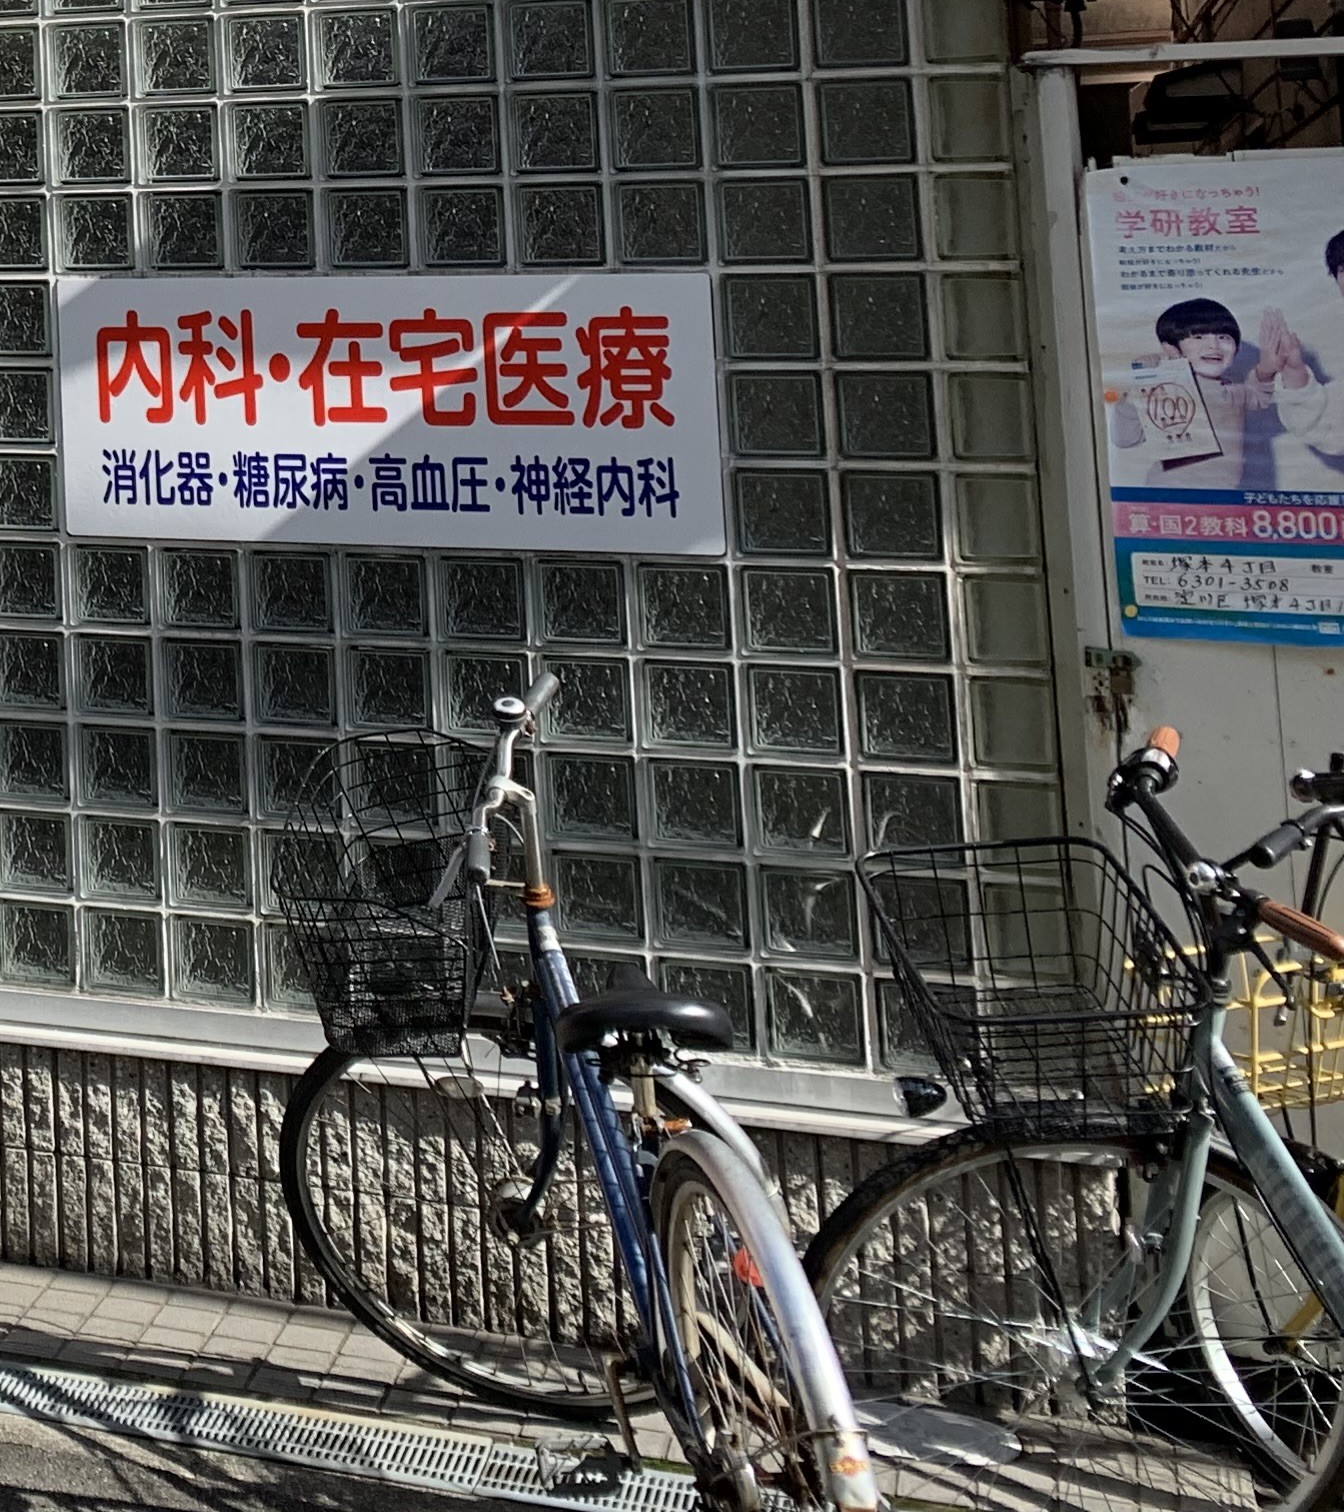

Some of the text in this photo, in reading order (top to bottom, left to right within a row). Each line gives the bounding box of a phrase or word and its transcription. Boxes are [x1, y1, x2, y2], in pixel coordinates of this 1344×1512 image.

[1115, 205, 1261, 239] 学研教室
[94, 305, 676, 430] 内科・在宅医療
[101, 448, 681, 519] 消化器・糖尿病・高血圧・神経内科
[1243, 492, 1344, 506] 子どもたちを応援
[1252, 509, 1344, 541] 8,800
[1178, 572, 1289, 592] 6301-3508
